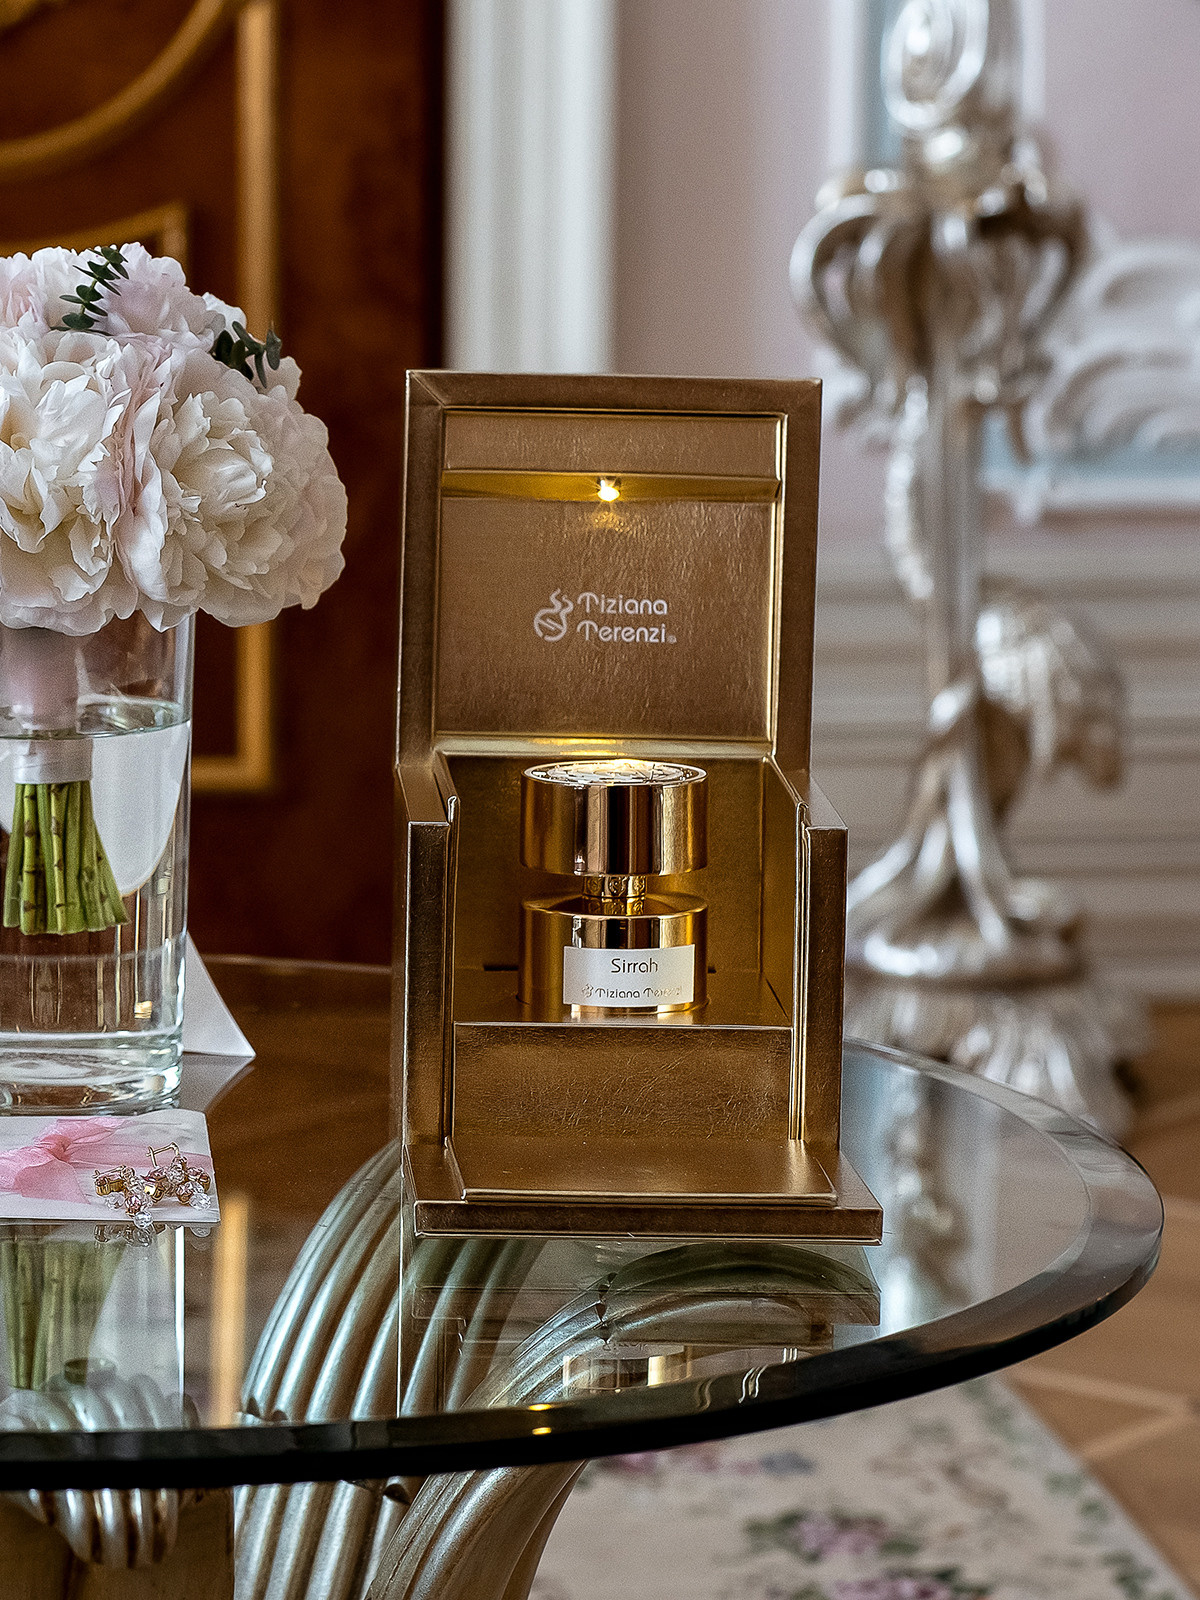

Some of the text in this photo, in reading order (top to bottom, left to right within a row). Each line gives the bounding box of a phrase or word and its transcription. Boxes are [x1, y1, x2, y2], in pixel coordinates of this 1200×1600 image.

[576, 591, 668, 615] Tiziana
[576, 620, 666, 643] Terenzi
[610, 957, 659, 974] Sirrah
[594, 986, 683, 999] Tiziana Tere
